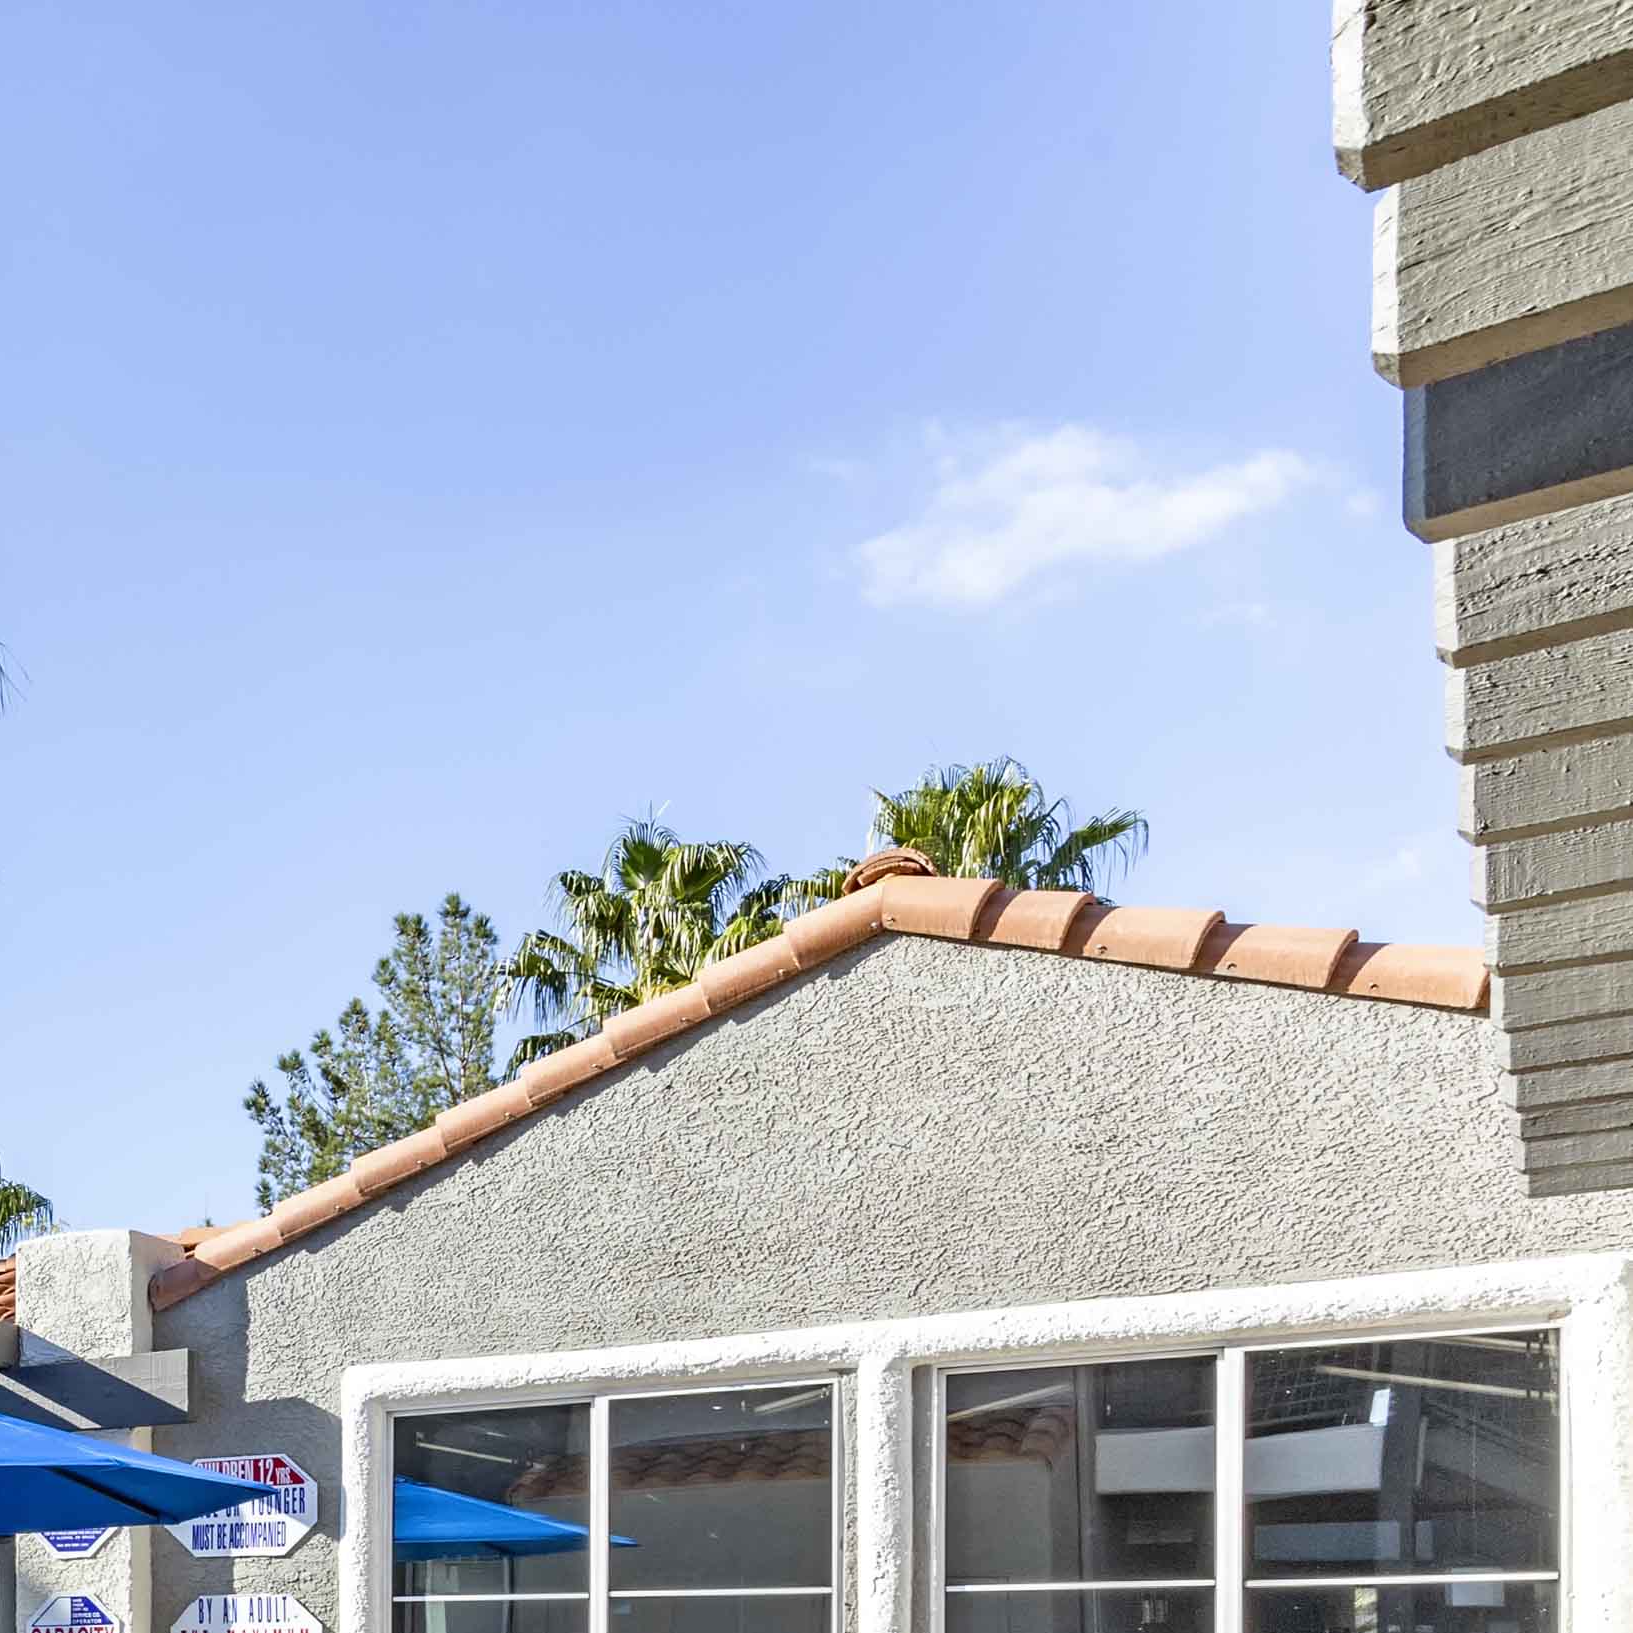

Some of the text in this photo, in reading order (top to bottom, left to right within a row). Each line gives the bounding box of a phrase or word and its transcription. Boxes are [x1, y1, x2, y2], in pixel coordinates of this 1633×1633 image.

[258, 1458, 274, 1485] 12
[192, 1521, 286, 1550] MUST BE ACCOMPANIED
[198, 1598, 213, 1624] BY
[223, 1597, 237, 1624] AN
